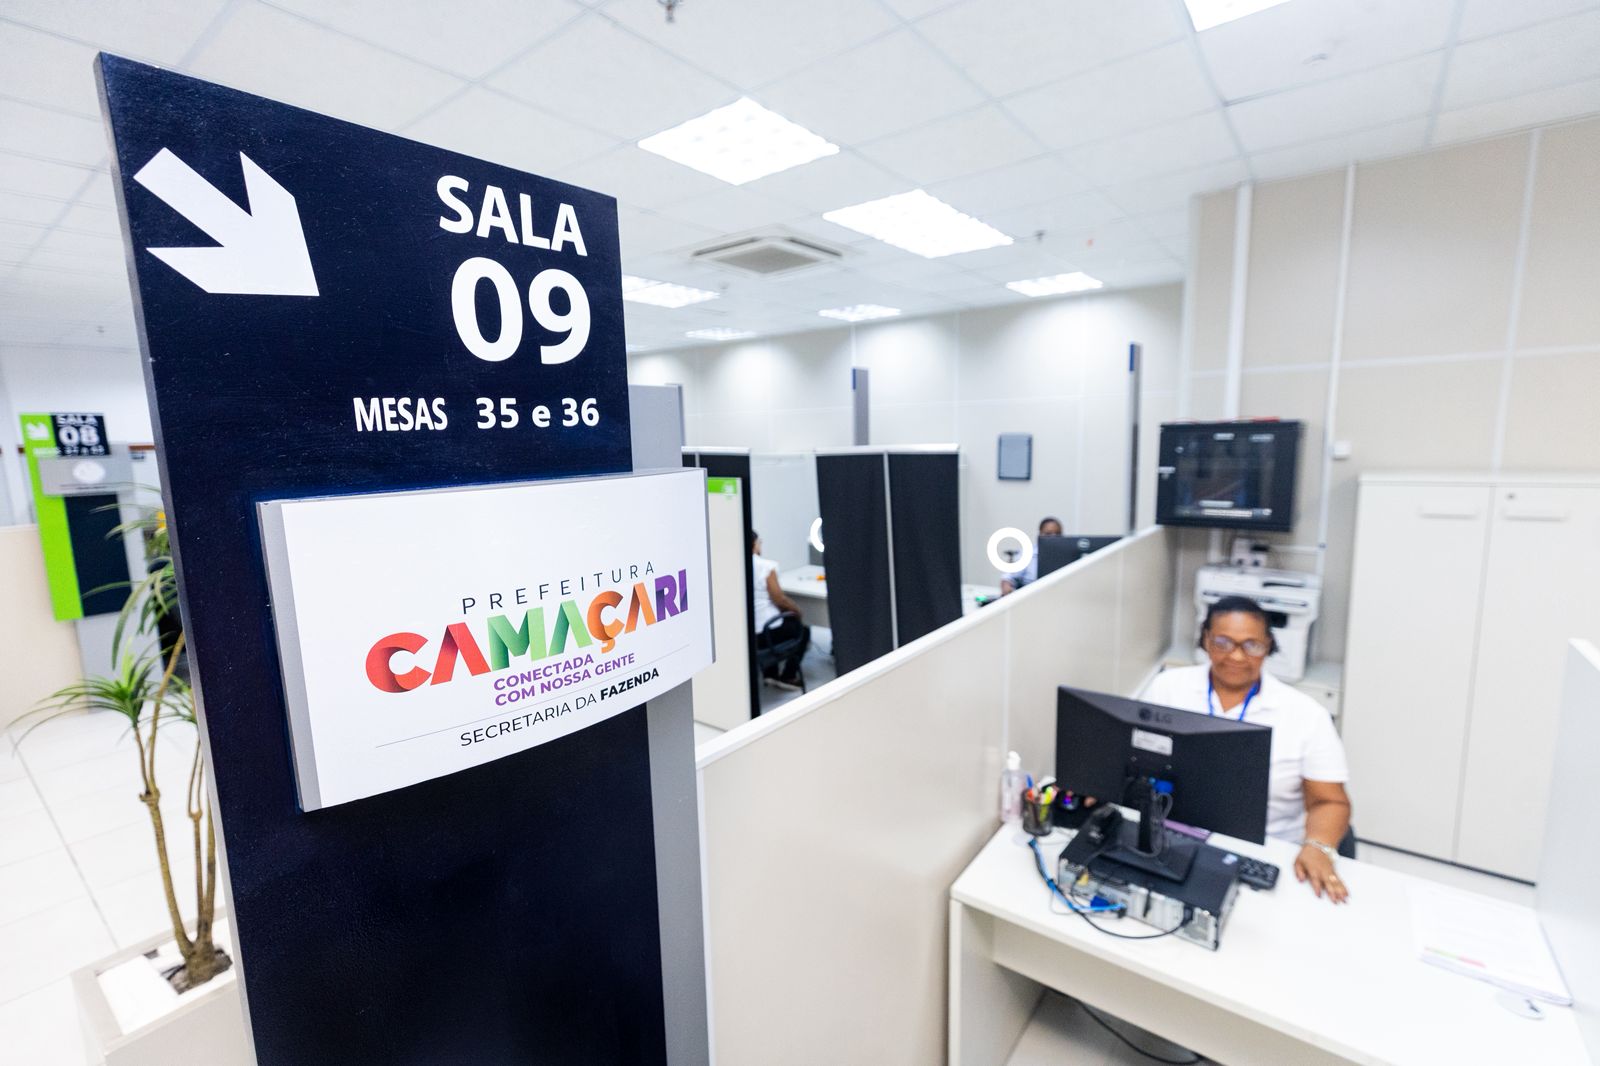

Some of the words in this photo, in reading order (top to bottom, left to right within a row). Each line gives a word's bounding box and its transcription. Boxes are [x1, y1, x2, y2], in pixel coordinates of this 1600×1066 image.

[436, 175, 587, 256] SALA
[451, 257, 591, 365] 09
[59, 424, 100, 447] 08
[353, 397, 448, 432] MESAS
[475, 397, 520, 429] 35
[531, 404, 551, 428] e
[561, 397, 600, 427] 36
[462, 561, 654, 614] PREFEITURA
[365, 569, 689, 693] CAMAÇARI
[493, 653, 595, 692] CONECTADA
[495, 687, 536, 707] COM
[539, 670, 592, 699] NOSSA
[595, 653, 635, 677] GENTE
[460, 703, 571, 746] SECRETARIA
[575, 692, 597, 711] DA
[600, 668, 660, 700] FAZENDA
